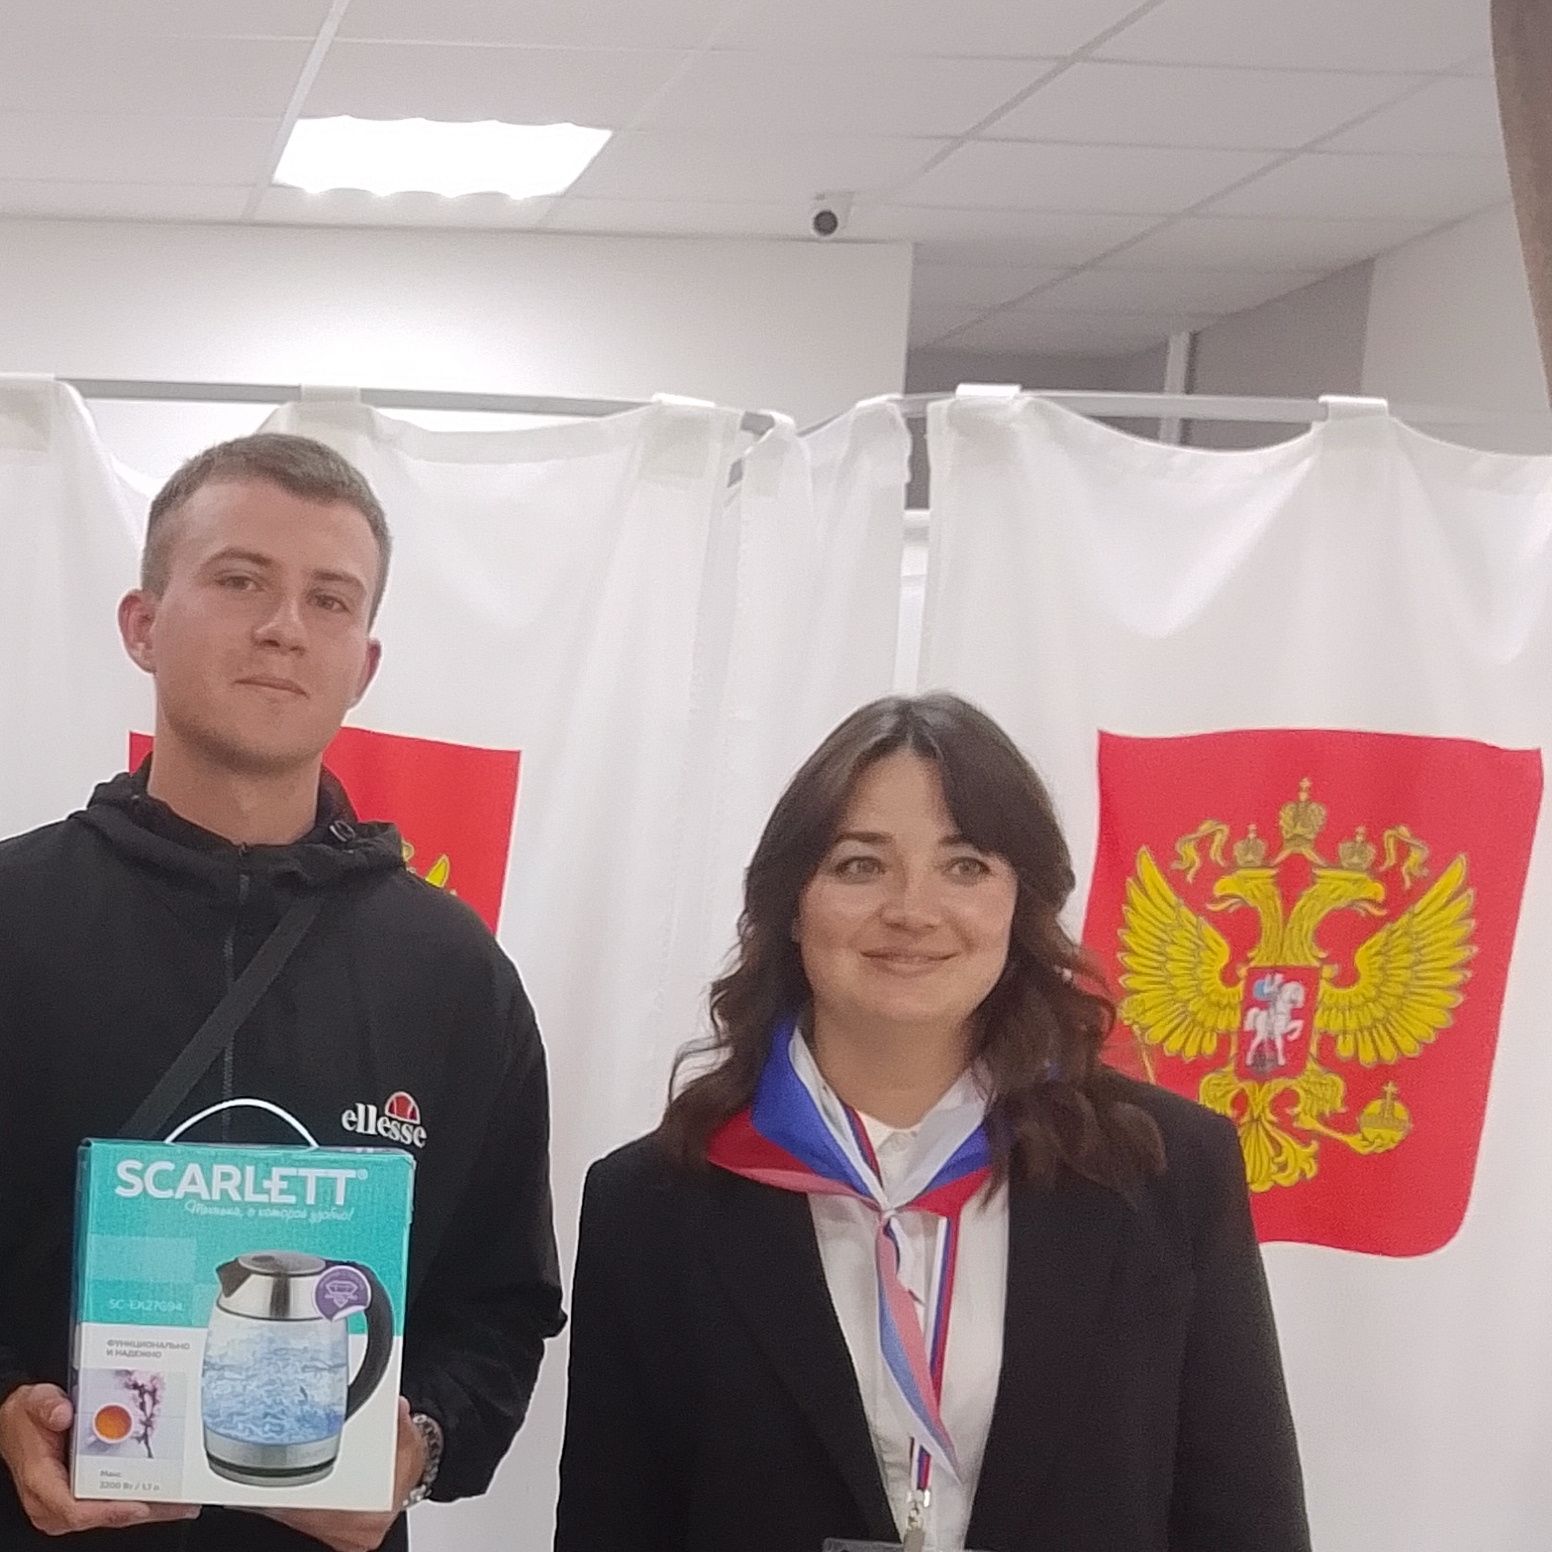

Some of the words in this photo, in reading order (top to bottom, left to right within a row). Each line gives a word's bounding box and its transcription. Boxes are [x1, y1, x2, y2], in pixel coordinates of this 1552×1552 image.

[341, 1102, 427, 1148] ellesse
[115, 1160, 357, 1205] SCARLETT
[106, 1339, 190, 1351] ФУНКЦИОНАЛЬНО
[106, 1349, 114, 1357] И
